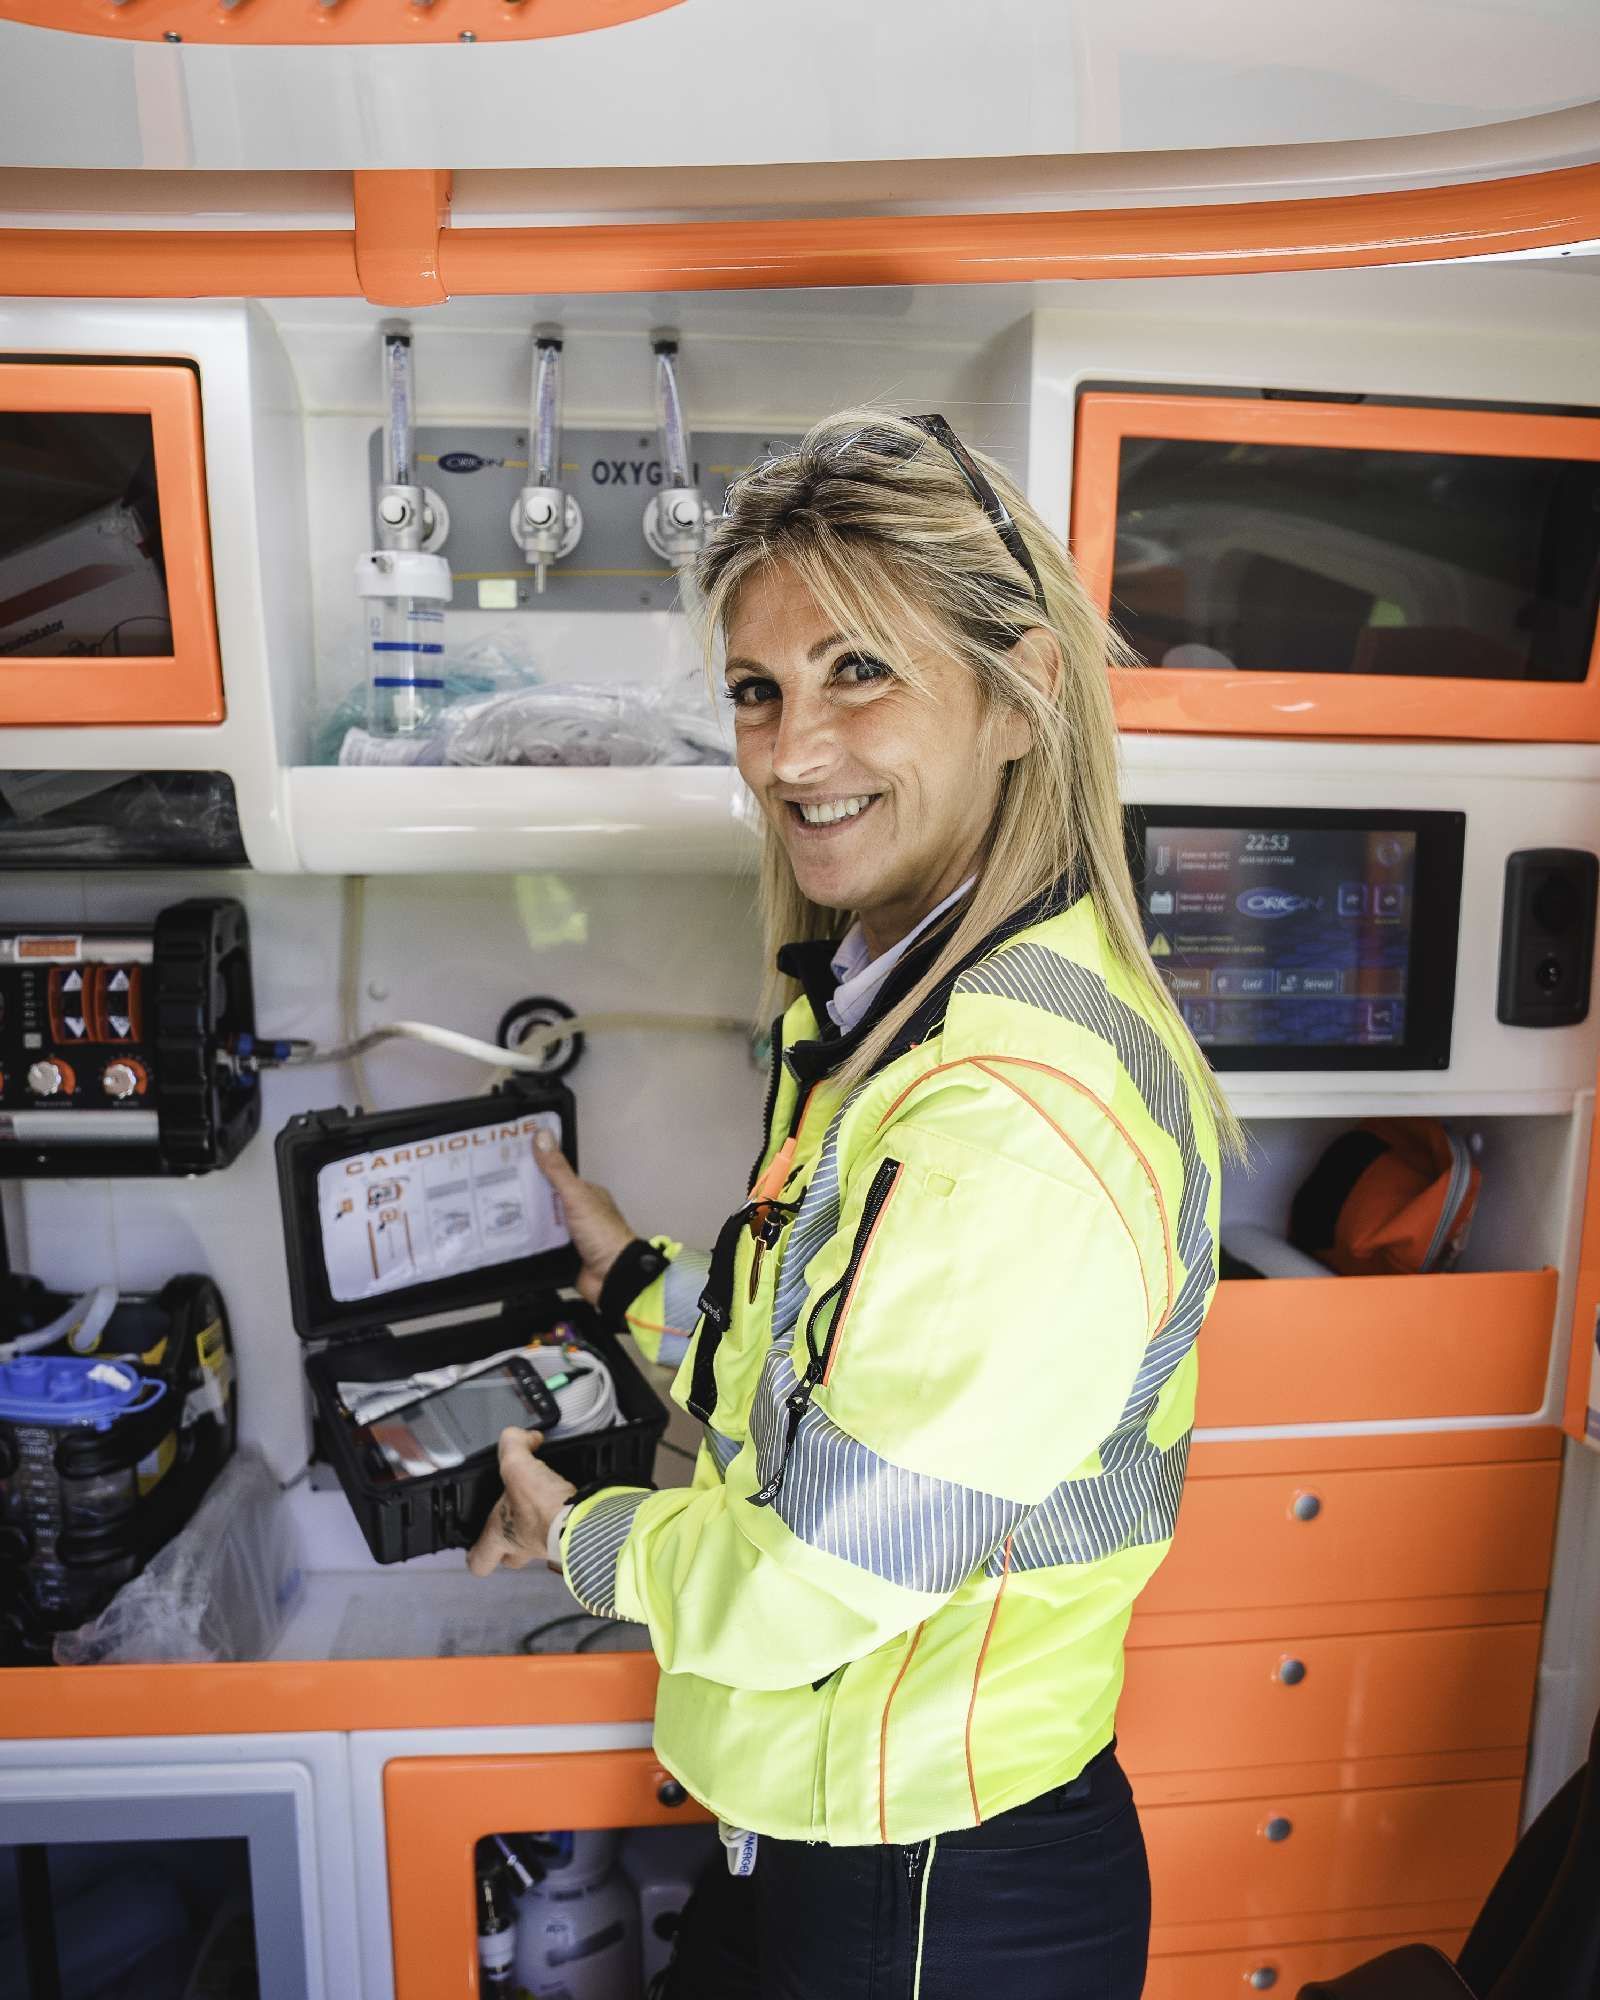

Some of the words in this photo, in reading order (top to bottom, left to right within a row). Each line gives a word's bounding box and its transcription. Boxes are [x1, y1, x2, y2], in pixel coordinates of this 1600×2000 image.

[592, 460, 699, 486] OXYG
[1245, 833, 1290, 851] 22:53
[345, 1118, 539, 1176] CARDIOLINE
